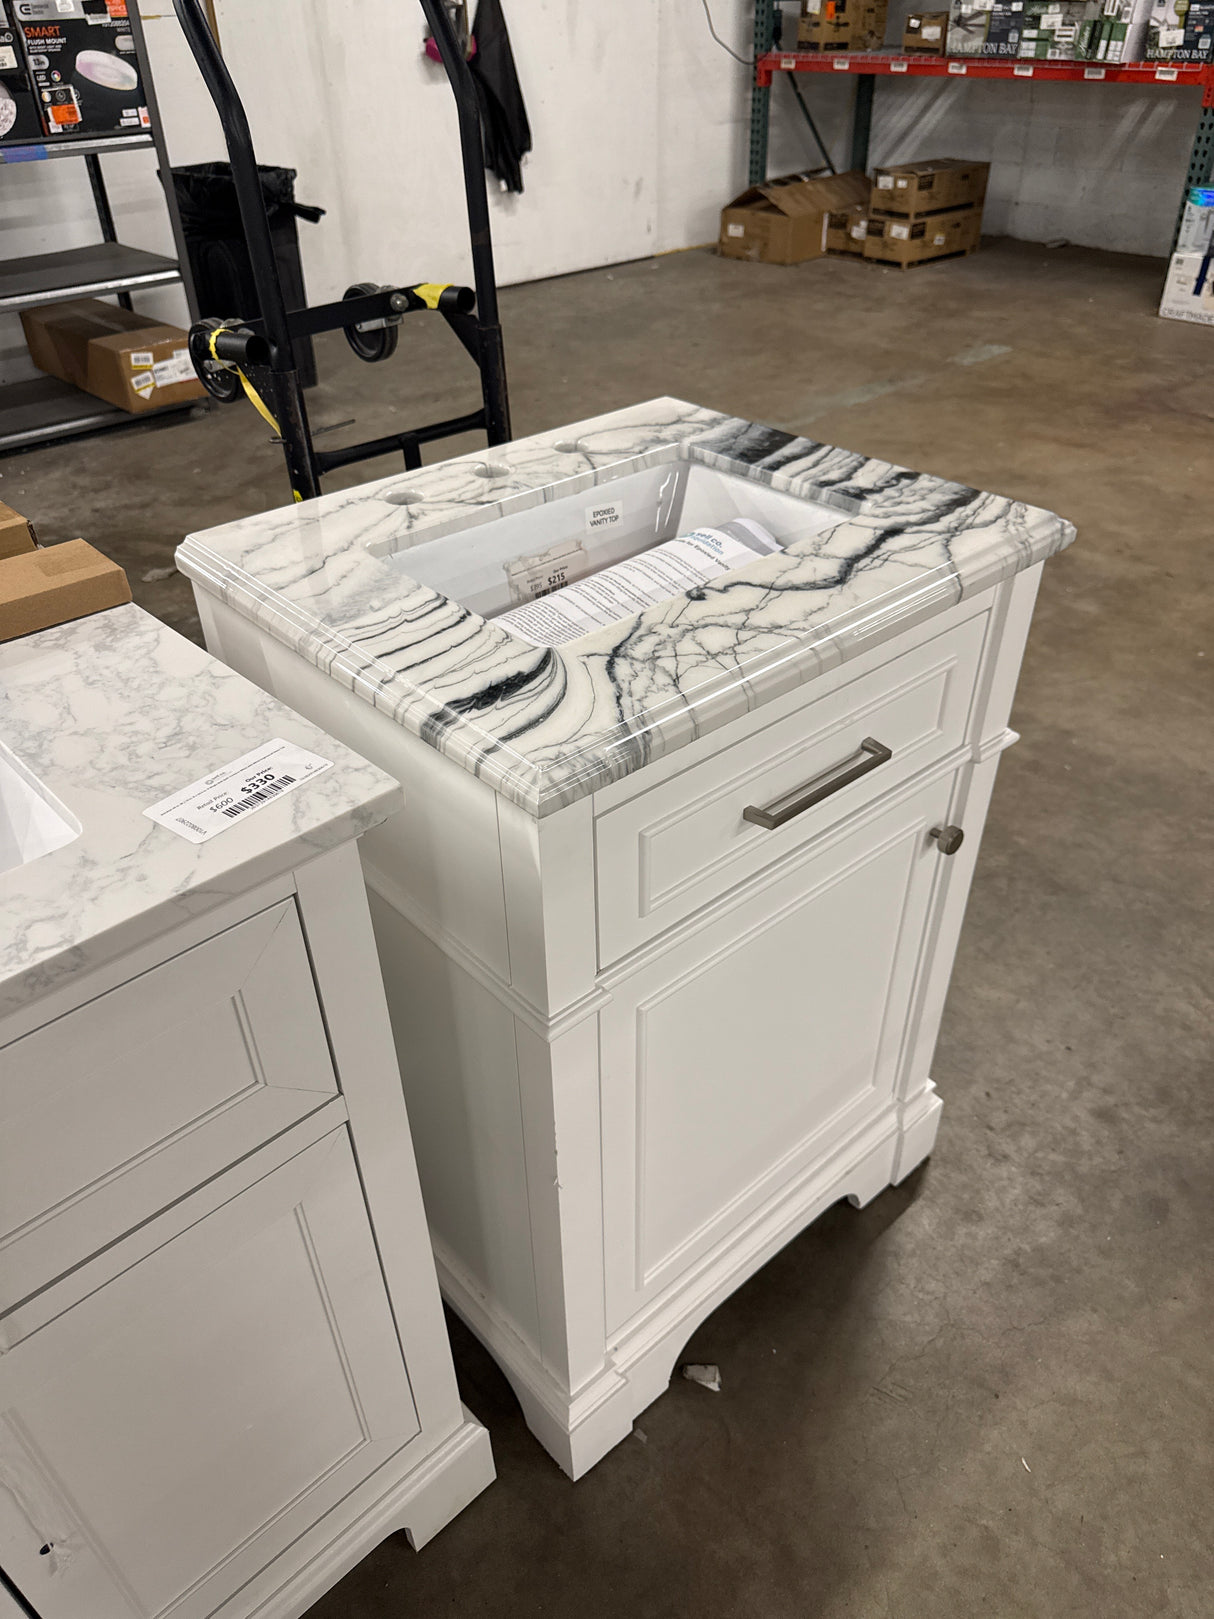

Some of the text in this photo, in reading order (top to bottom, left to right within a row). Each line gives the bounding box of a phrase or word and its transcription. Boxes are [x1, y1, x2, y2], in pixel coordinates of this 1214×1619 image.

[24, 26, 60, 37] SMART
[999, 42, 1018, 54] BAY
[1147, 49, 1209, 59] HAMPTON BAY
[592, 507, 615, 518] EPOXIED
[589, 514, 619, 527] VANITY TOP
[547, 572, 565, 586] $215
[241, 773, 275, 794] $330
[245, 774, 257, 782] Our
[209, 797, 234, 812] $600
